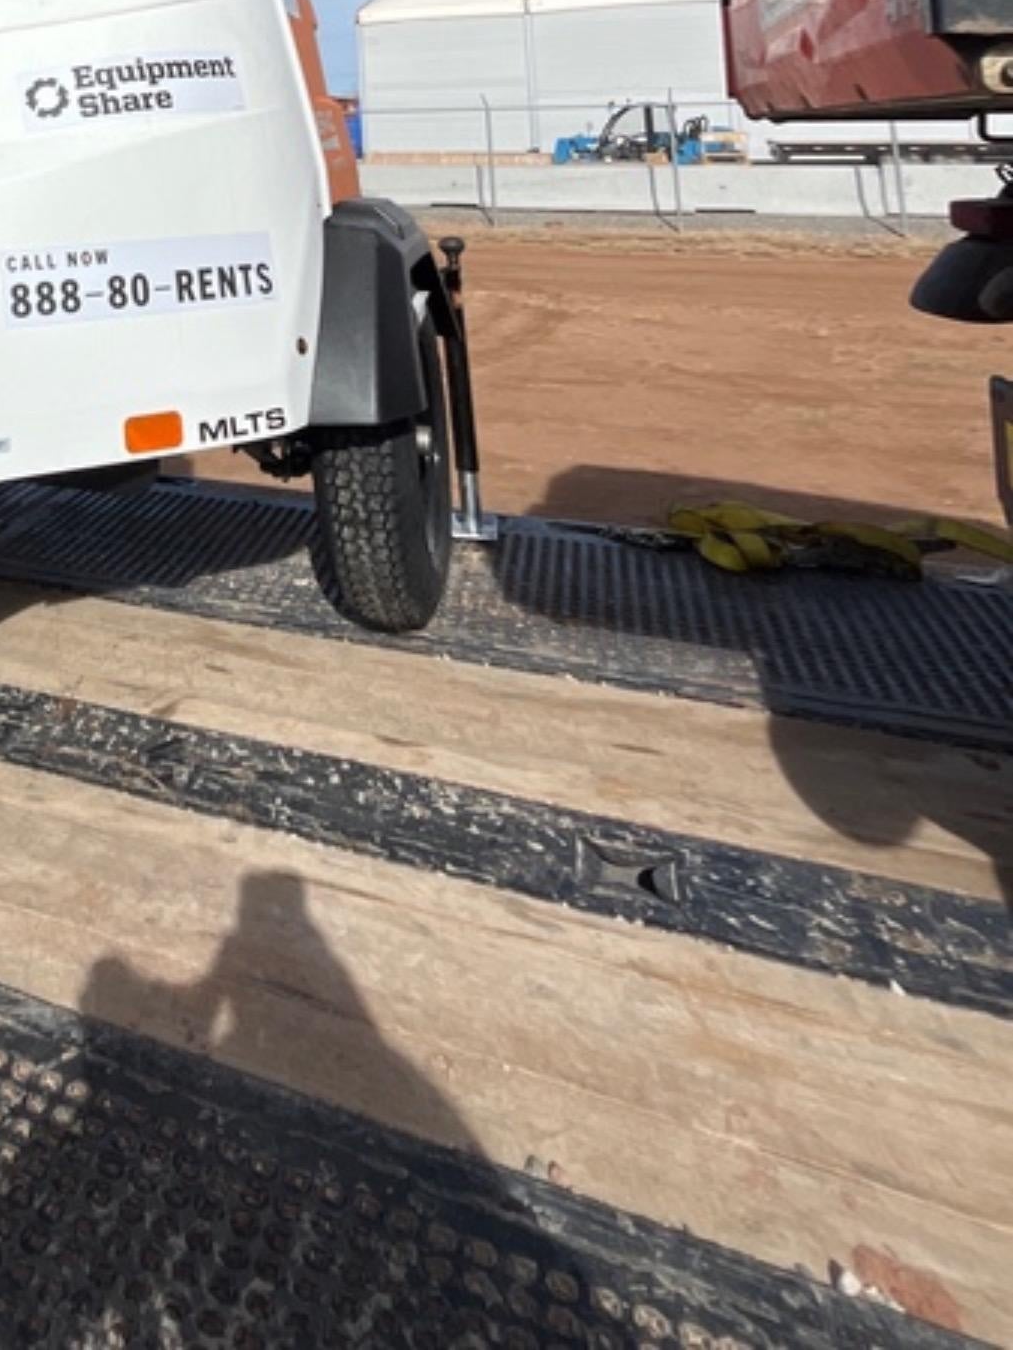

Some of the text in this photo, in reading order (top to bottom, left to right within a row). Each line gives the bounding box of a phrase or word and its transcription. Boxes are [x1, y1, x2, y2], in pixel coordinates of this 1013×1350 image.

[71, 56, 237, 90] Equipment
[78, 89, 174, 118] Share
[6, 250, 109, 272] CALL NOW
[10, 263, 274, 318] 888-80-RENTS
[199, 407, 286, 443] MLTS
